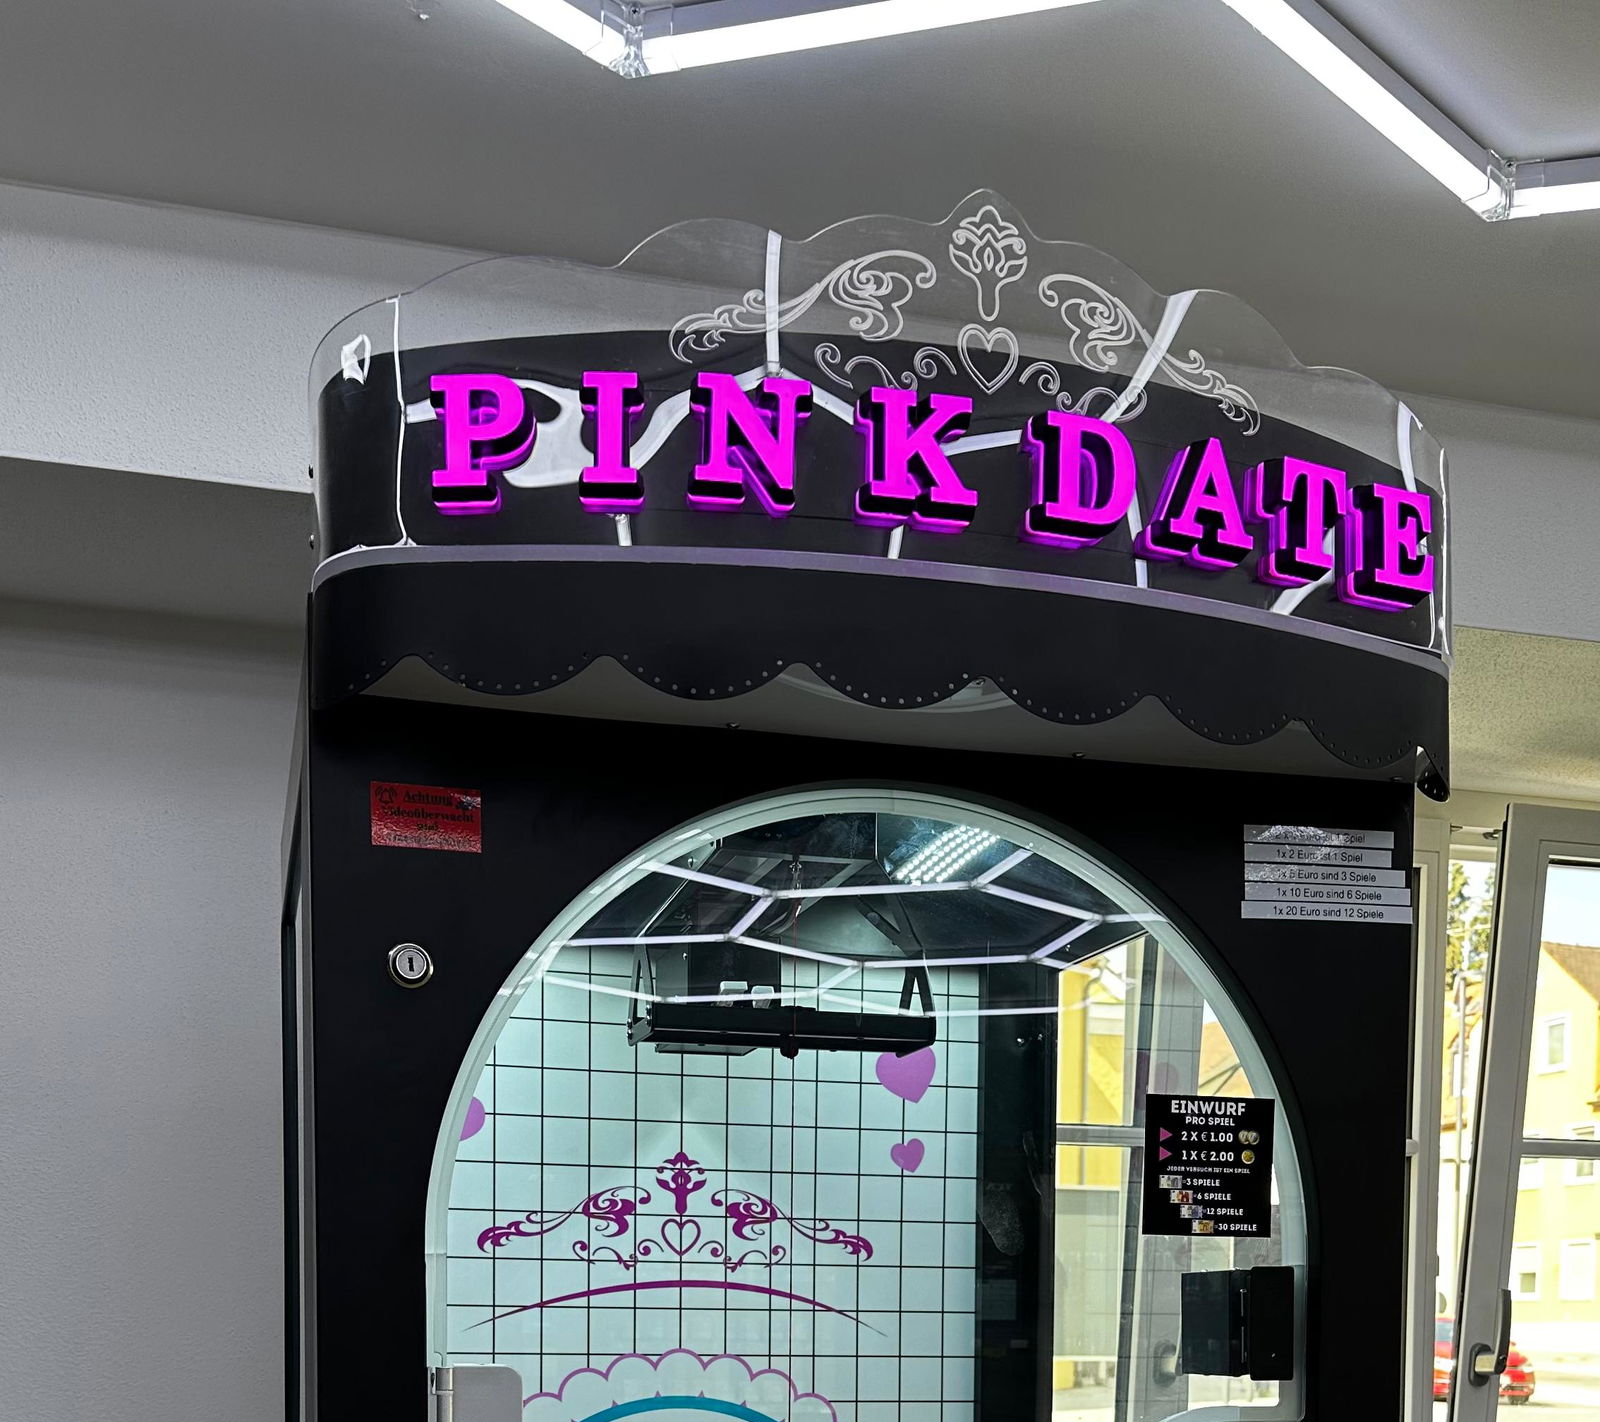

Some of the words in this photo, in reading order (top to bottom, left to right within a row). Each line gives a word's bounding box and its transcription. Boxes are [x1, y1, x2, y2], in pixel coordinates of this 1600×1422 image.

[430, 370, 978, 532] PINK
[1018, 409, 1434, 610] DATE
[1343, 833, 1366, 844] Spiel
[1276, 849, 1287, 859] 1x
[1289, 849, 1295, 859] 2
[1333, 853, 1338, 861] 1
[1340, 852, 1363, 864] Spiel
[1289, 868, 1295, 878] 5
[1297, 869, 1319, 880] Euro
[1320, 871, 1339, 881] sind
[1341, 871, 1347, 881] 3
[1349, 871, 1377, 883] Spiele
[1277, 887, 1287, 897] 1x
[1290, 887, 1301, 898] 10
[1303, 888, 1324, 898] Euro
[1326, 889, 1345, 899] sind
[1346, 890, 1353, 900] 6
[1355, 890, 1382, 902] Spiele
[1273, 905, 1283, 915] 1x
[1286, 905, 1298, 916] 20
[1299, 906, 1321, 917] Euro
[1323, 907, 1341, 917] sind
[1344, 908, 1355, 918] 12
[1356, 908, 1384, 920] Spiele
[1170, 1099, 1247, 1116] EINWURF
[1185, 1116, 1206, 1125] PRO
[1207, 1116, 1236, 1126] SPIEL
[1181, 1131, 1188, 1141] 2
[1201, 1132, 1208, 1142] €
[1210, 1132, 1234, 1143] 1.00
[1182, 1150, 1187, 1160] 1
[1201, 1151, 1207, 1161] €
[1209, 1151, 1234, 1162] 2.00
[1192, 1179, 1221, 1187] SPIELE
[1203, 1193, 1232, 1201] SPIELE
[1216, 1208, 1244, 1216] SPIELE
[1229, 1224, 1258, 1232] SPIELE
